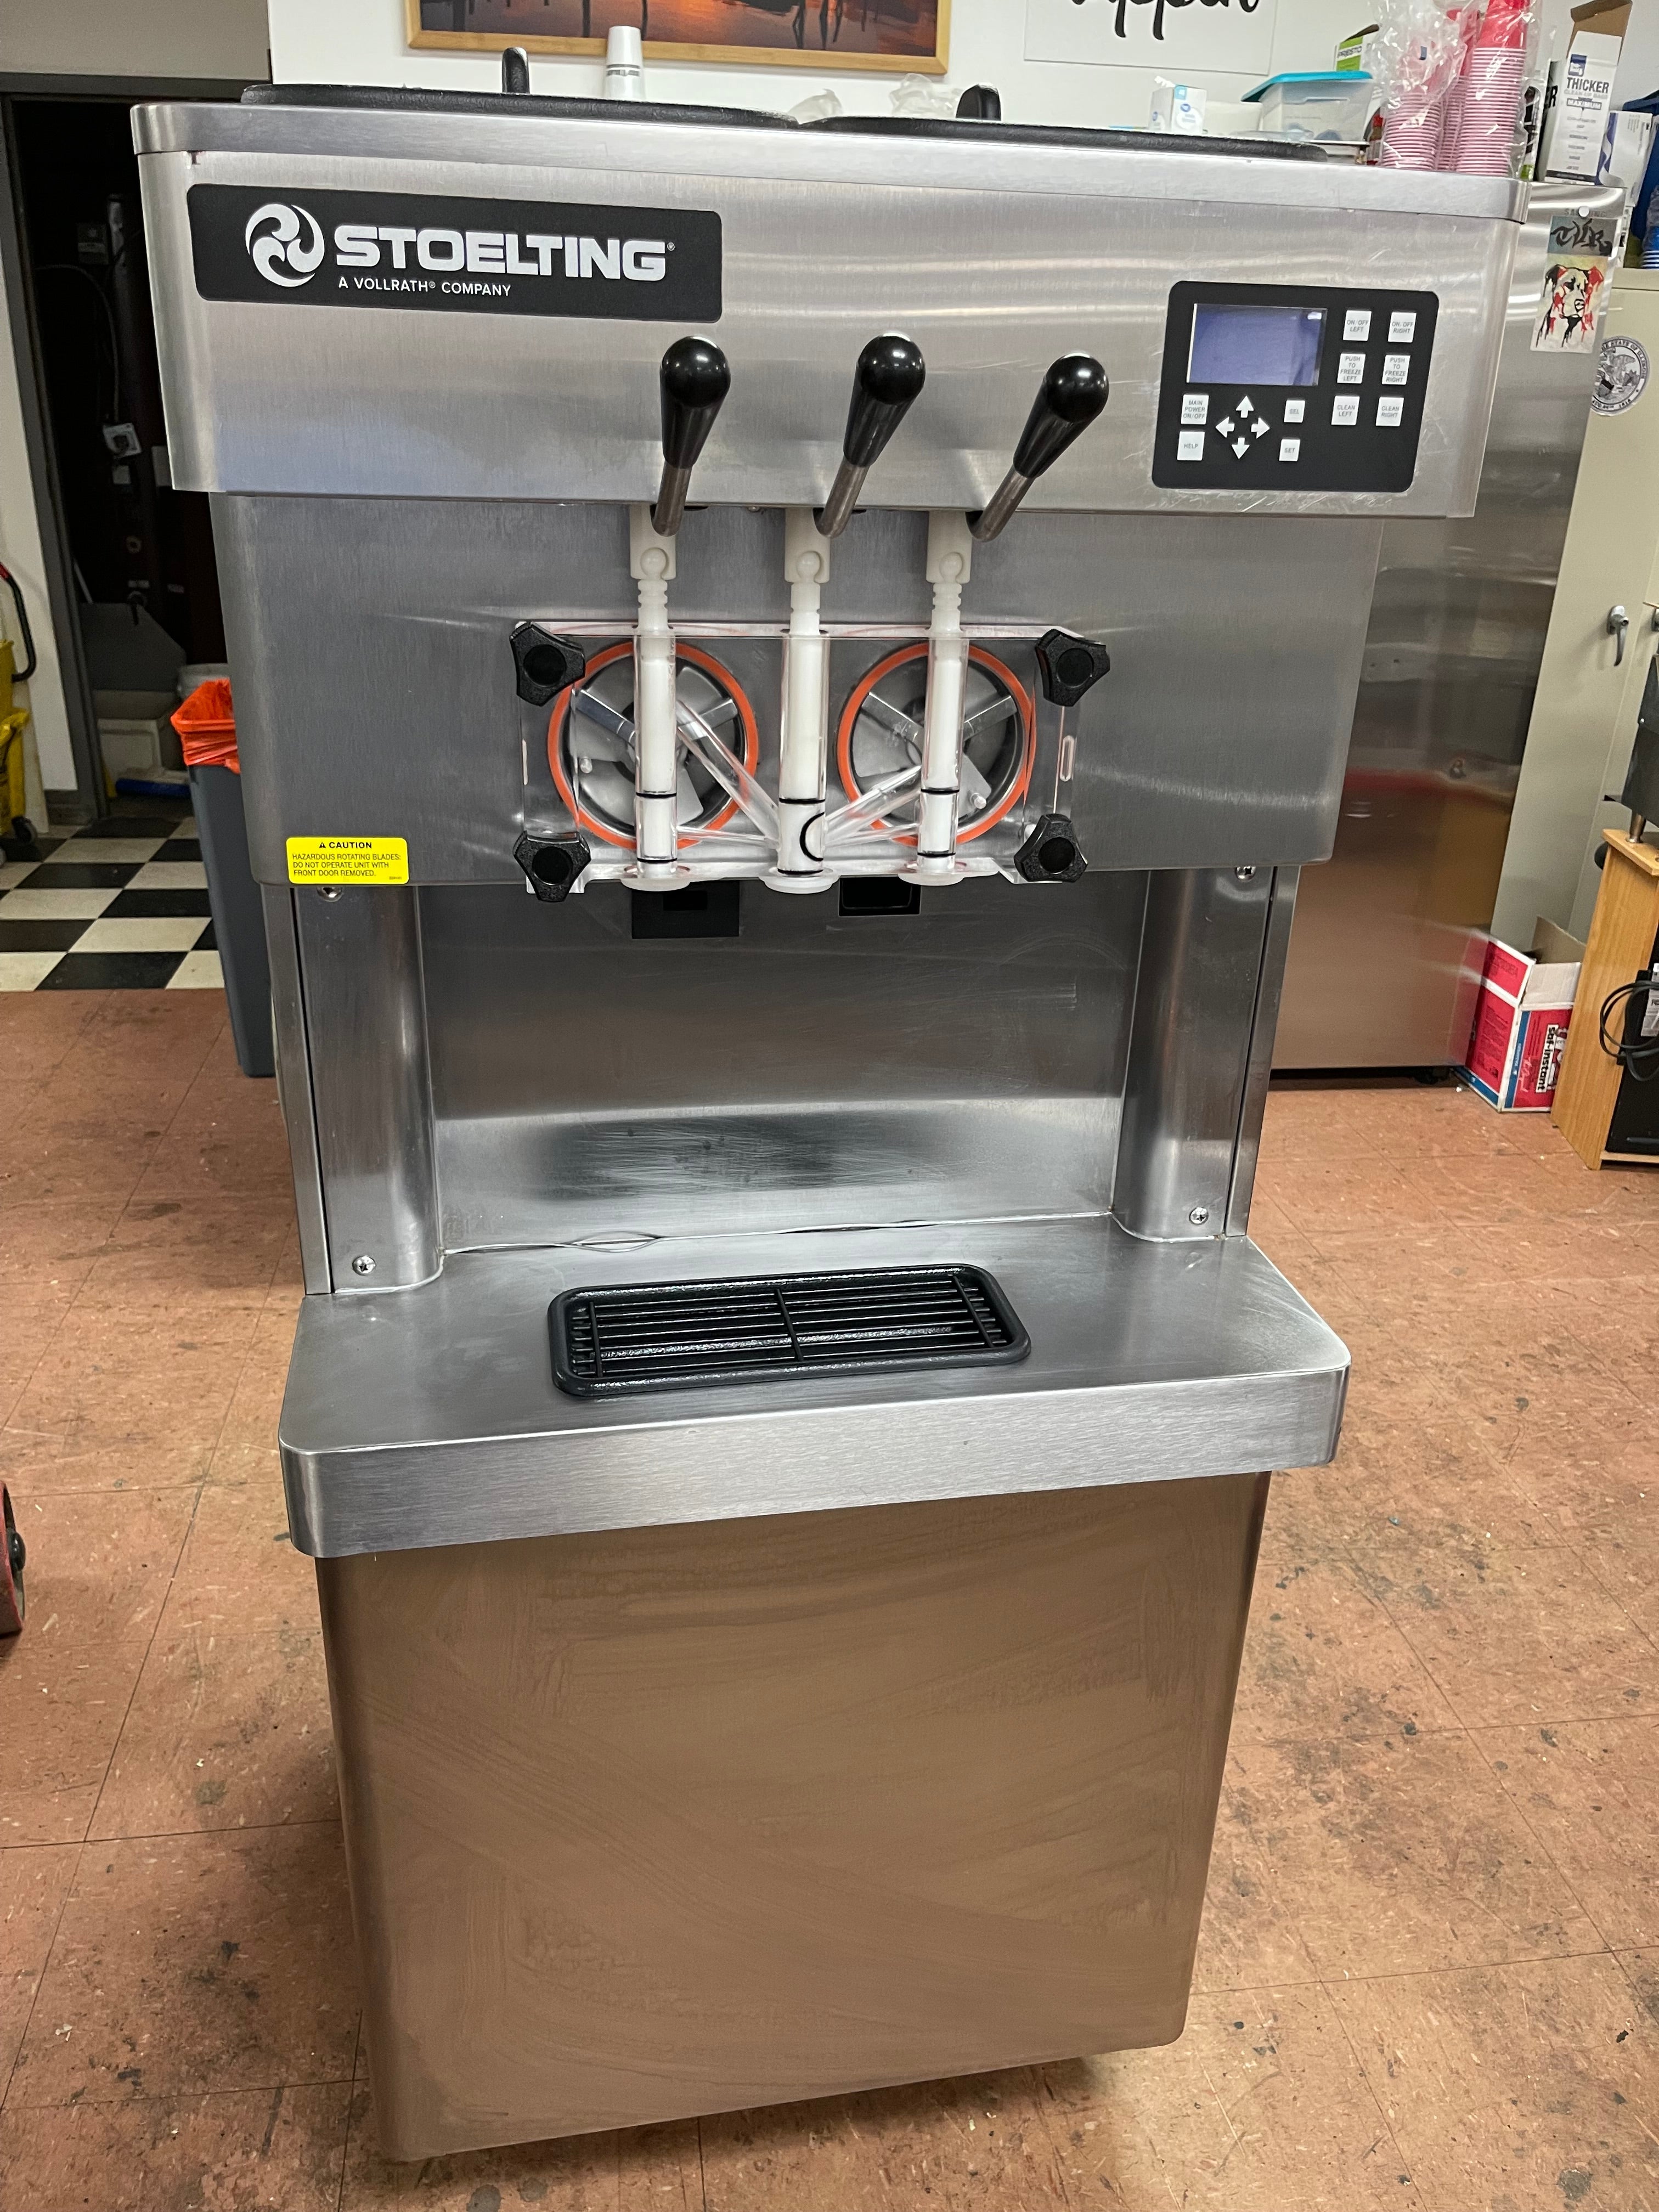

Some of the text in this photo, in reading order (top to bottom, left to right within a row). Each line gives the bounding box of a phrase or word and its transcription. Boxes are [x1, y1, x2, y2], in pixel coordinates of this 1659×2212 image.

[1567, 77, 1610, 94] THICKER
[338, 276, 348, 289] A
[441, 282, 511, 296] COMPANY
[1537, 1026, 1556, 1091] saf-instant
